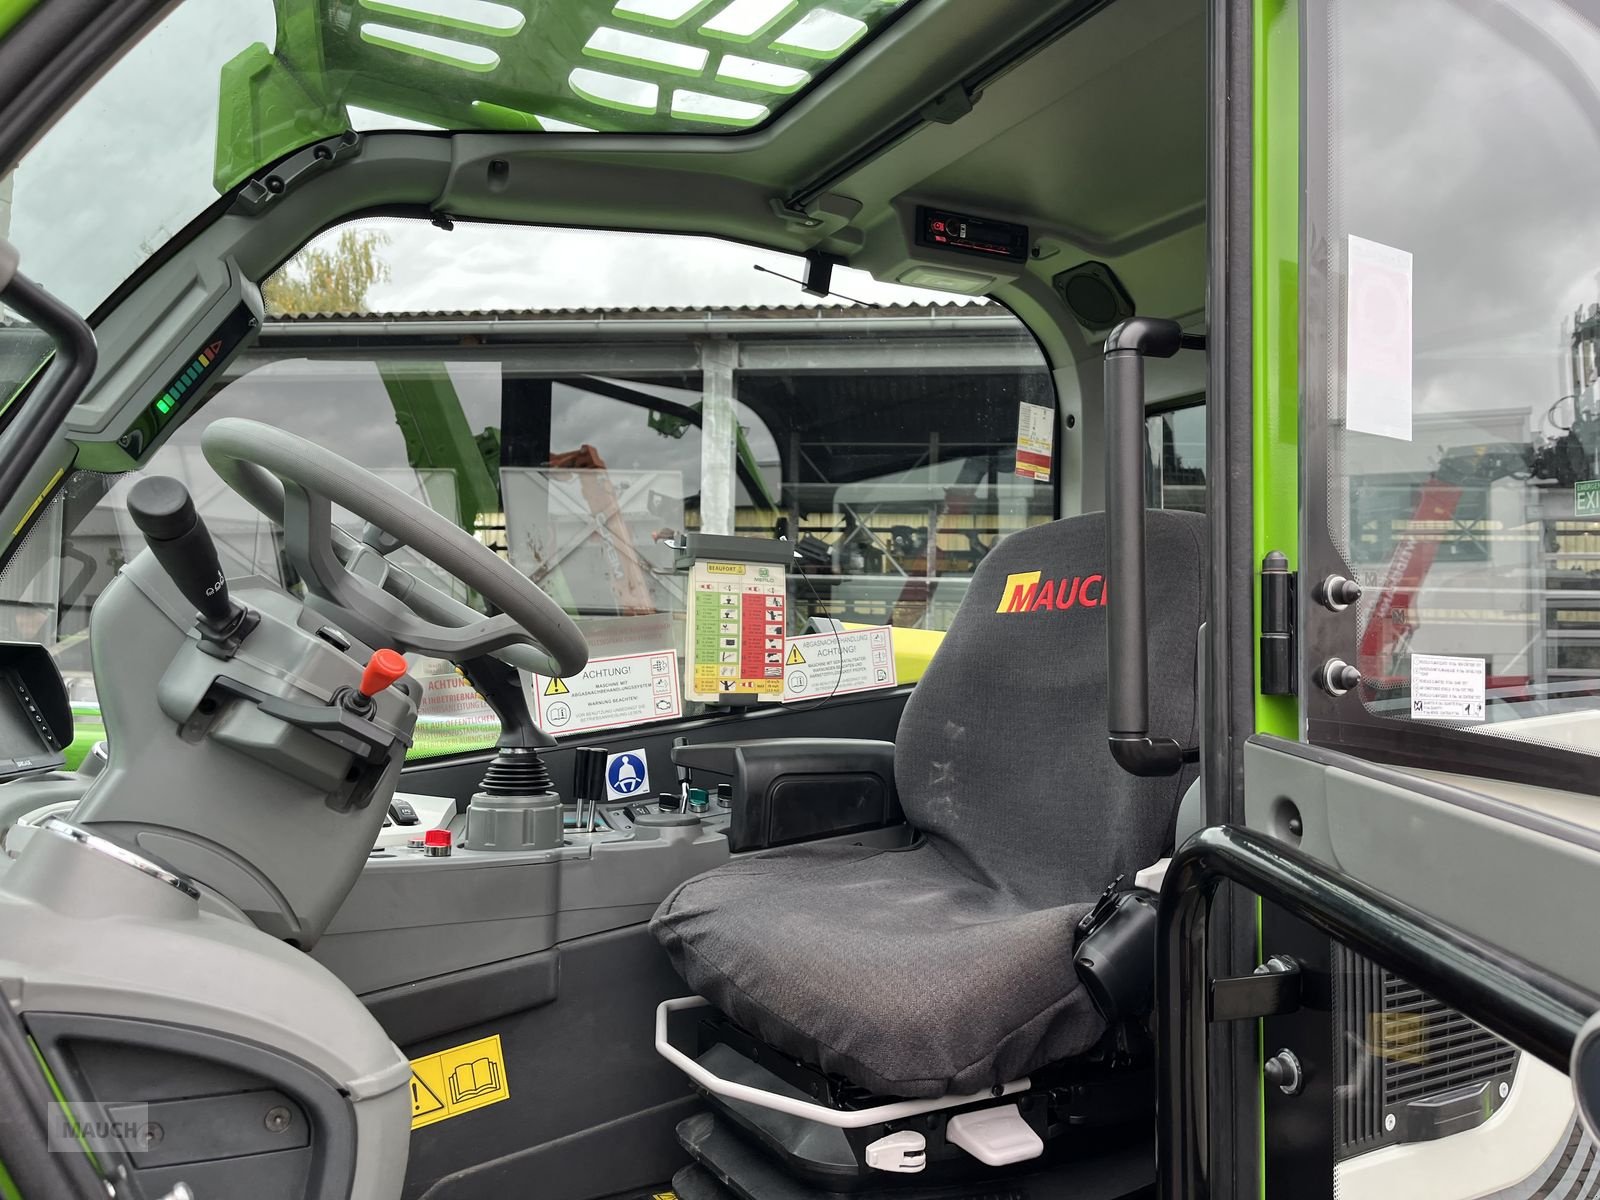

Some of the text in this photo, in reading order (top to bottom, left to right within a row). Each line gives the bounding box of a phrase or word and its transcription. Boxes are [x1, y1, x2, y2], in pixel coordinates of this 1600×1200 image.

[1577, 490, 1600, 510] EXI
[1007, 573, 1107, 612] MAUC
[803, 635, 868, 648] ABGASNACHBHANDLUNG
[582, 666, 631, 680] ACHTUNG!
[428, 677, 465, 690] ACHTUN
